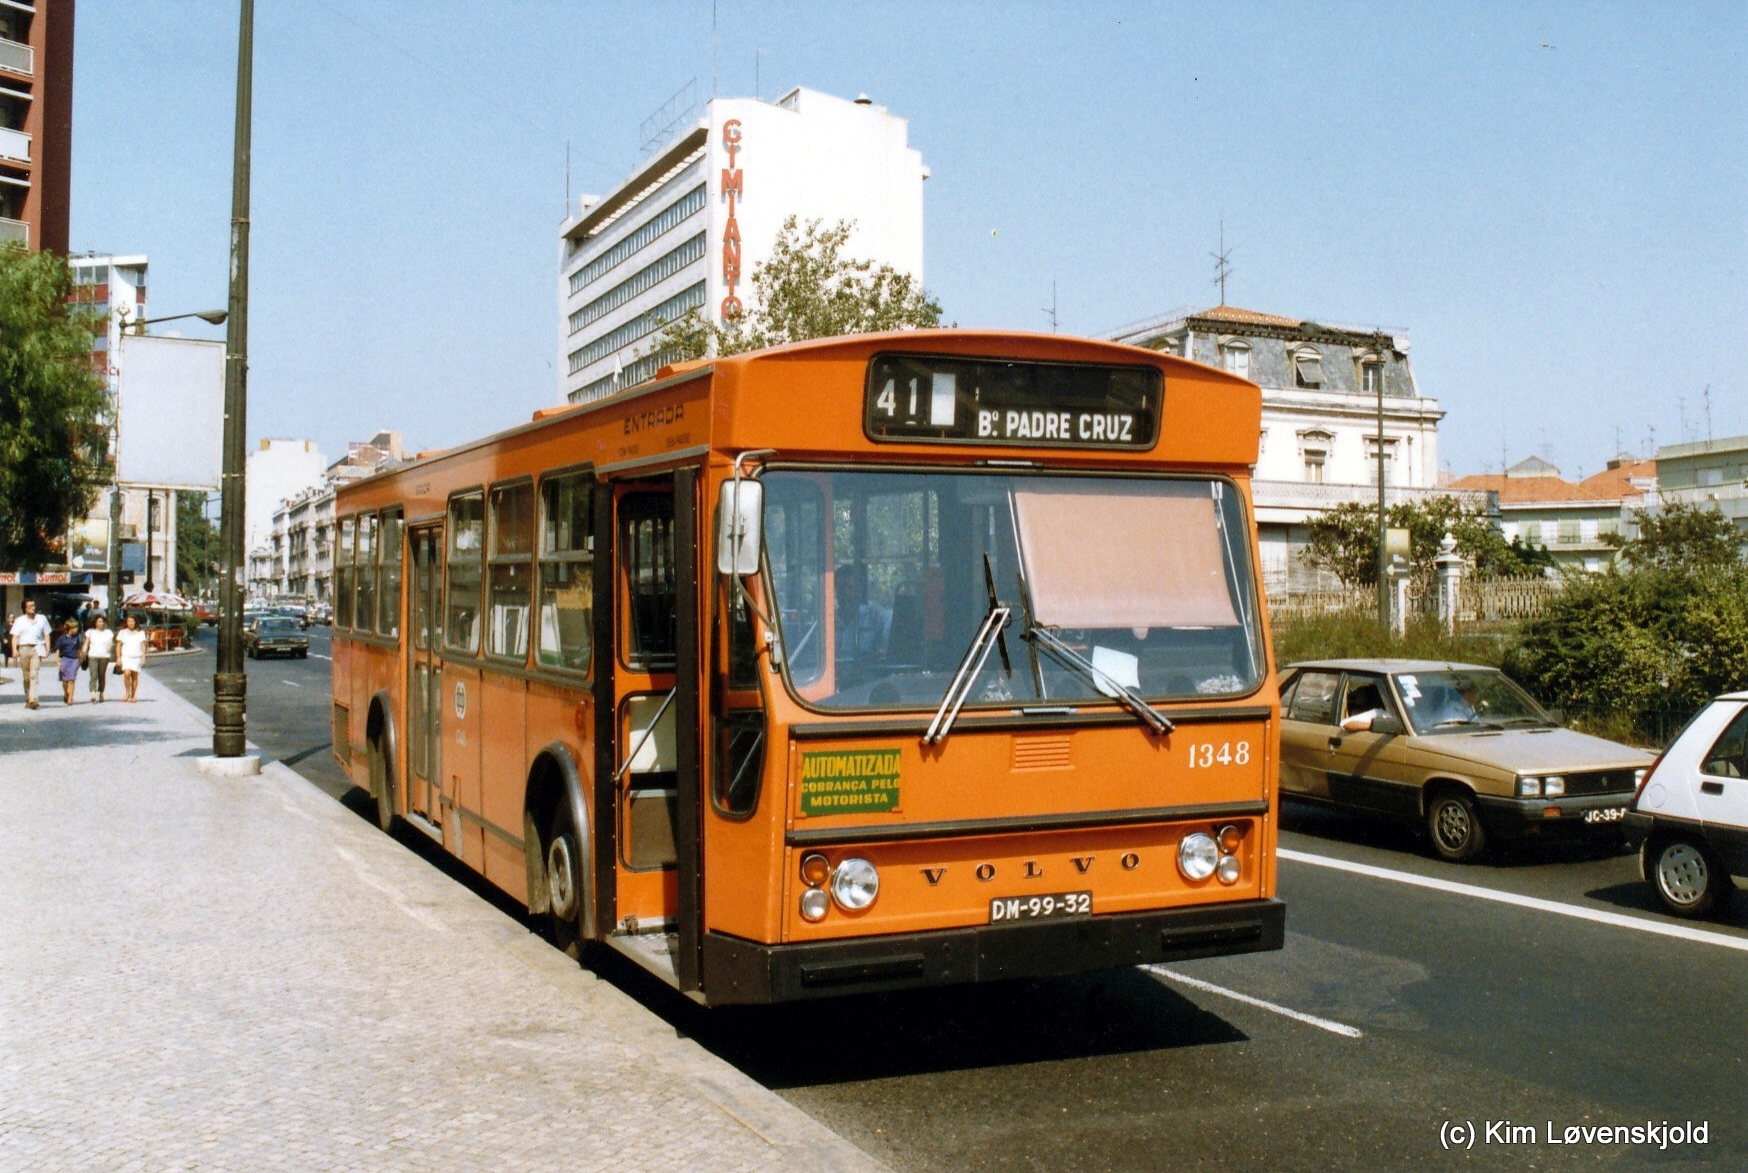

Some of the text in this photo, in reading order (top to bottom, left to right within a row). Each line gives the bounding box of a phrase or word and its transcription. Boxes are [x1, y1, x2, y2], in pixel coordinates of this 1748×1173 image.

[721, 119, 743, 320] CIMIANTO
[877, 378, 918, 416] 41
[624, 404, 684, 435] ENTRADA
[1006, 411, 1070, 439] PADRE
[1079, 414, 1132, 441] CRUZ
[39, 572, 67, 583] Sumol
[802, 754, 900, 778] AUTOMATIZADA
[1189, 741, 1250, 769] 1348
[801, 780, 867, 793] COBRANÇA
[810, 793, 888, 806] MOTORISTA
[920, 853, 1140, 886] VOLVO
[992, 894, 1091, 921] DM-99-32
